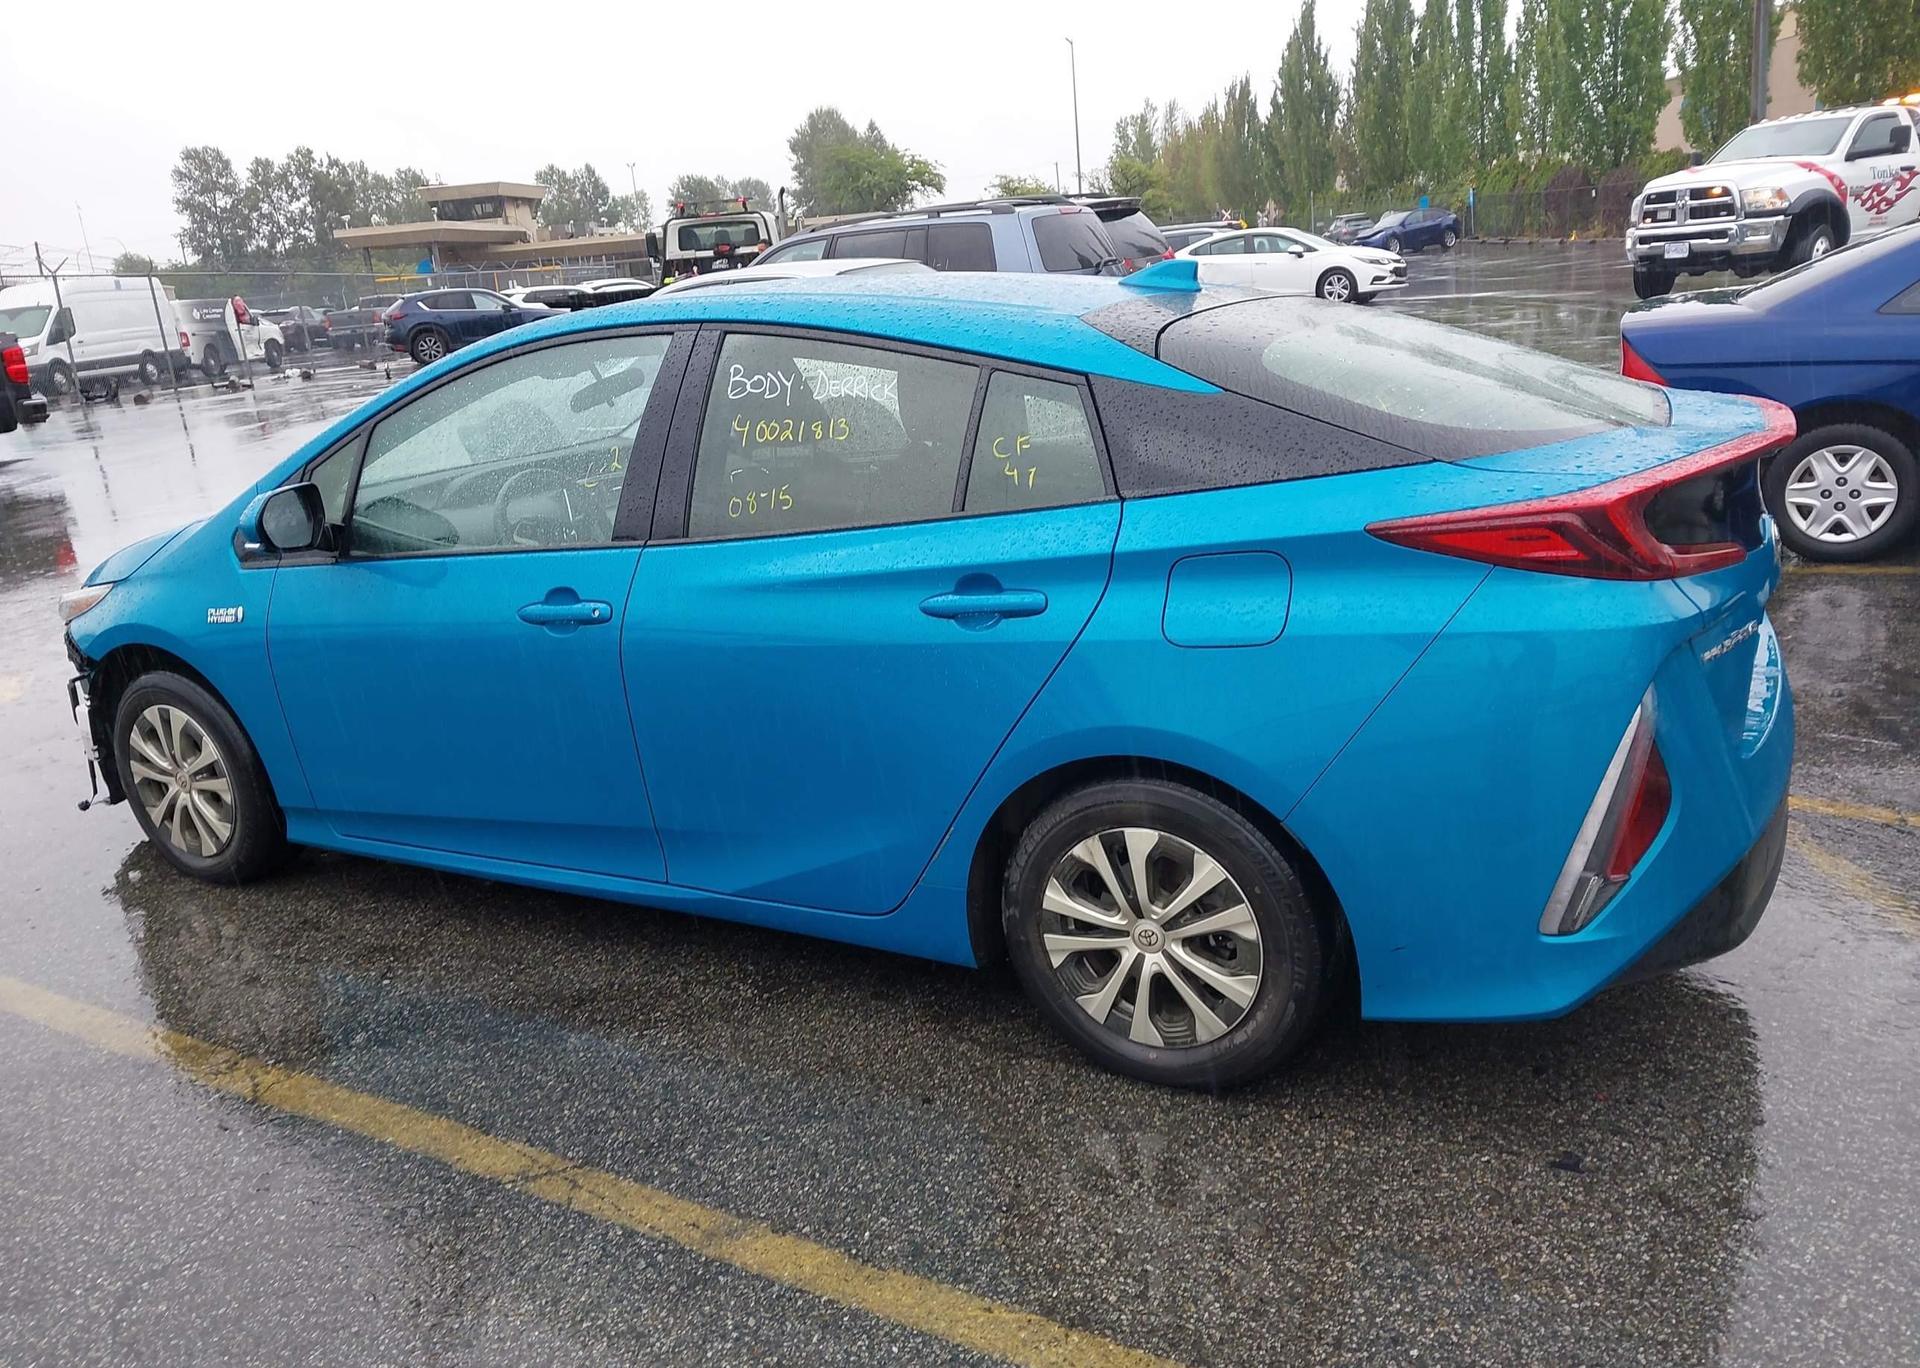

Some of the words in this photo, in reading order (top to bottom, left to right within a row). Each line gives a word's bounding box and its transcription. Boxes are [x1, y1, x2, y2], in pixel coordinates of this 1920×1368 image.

[812, 369, 899, 401] DERRICK
[731, 413, 850, 448] 40021813
[728, 483, 793, 518] 08-15
